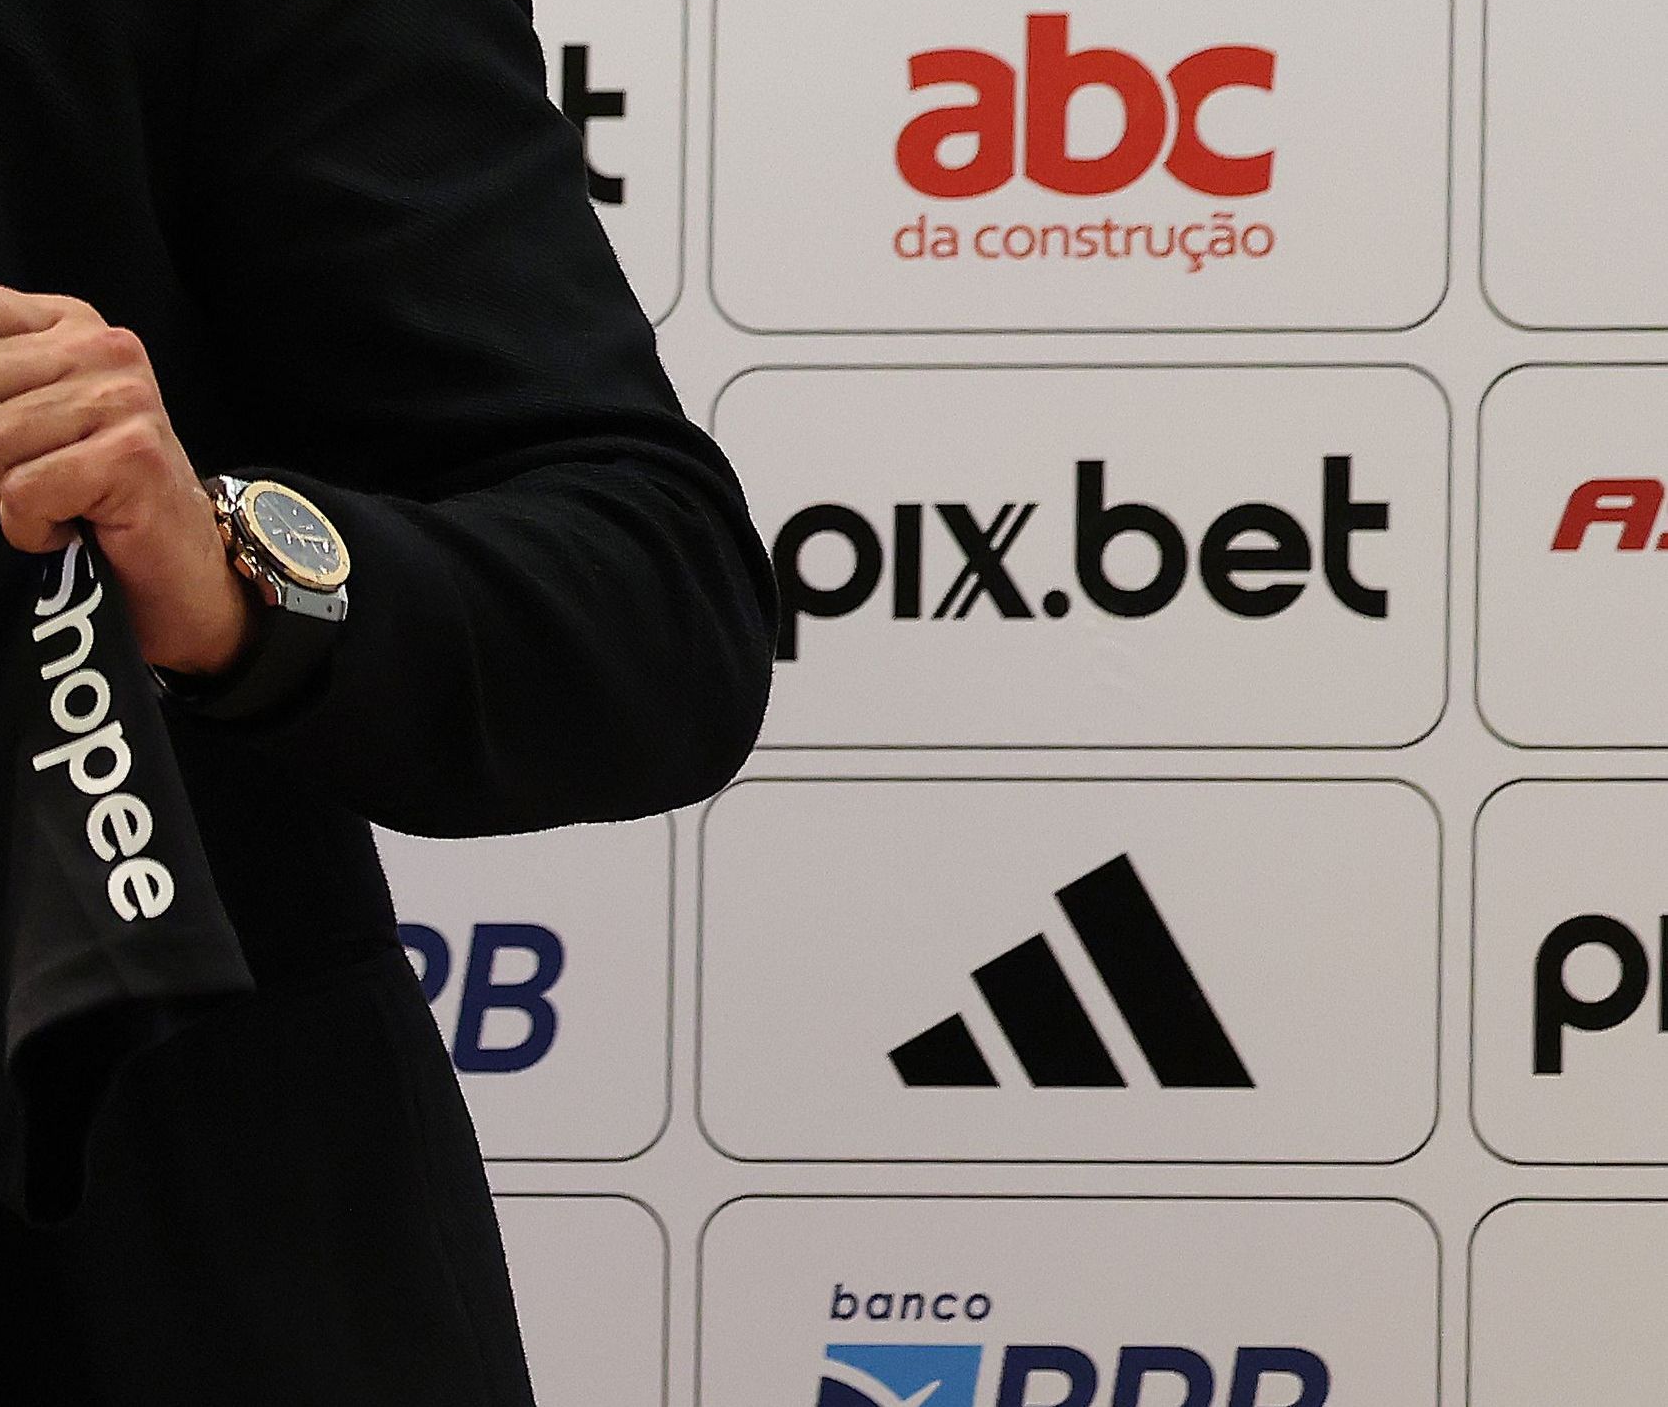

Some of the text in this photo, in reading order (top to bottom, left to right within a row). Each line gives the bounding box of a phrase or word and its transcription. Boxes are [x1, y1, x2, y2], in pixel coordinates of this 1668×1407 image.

[895, 13, 1276, 199] abc
[894, 212, 1274, 273] da construção
[1551, 478, 1668, 549] A
[770, 454, 1391, 663] pix.bet
[831, 1284, 991, 1320] banco
